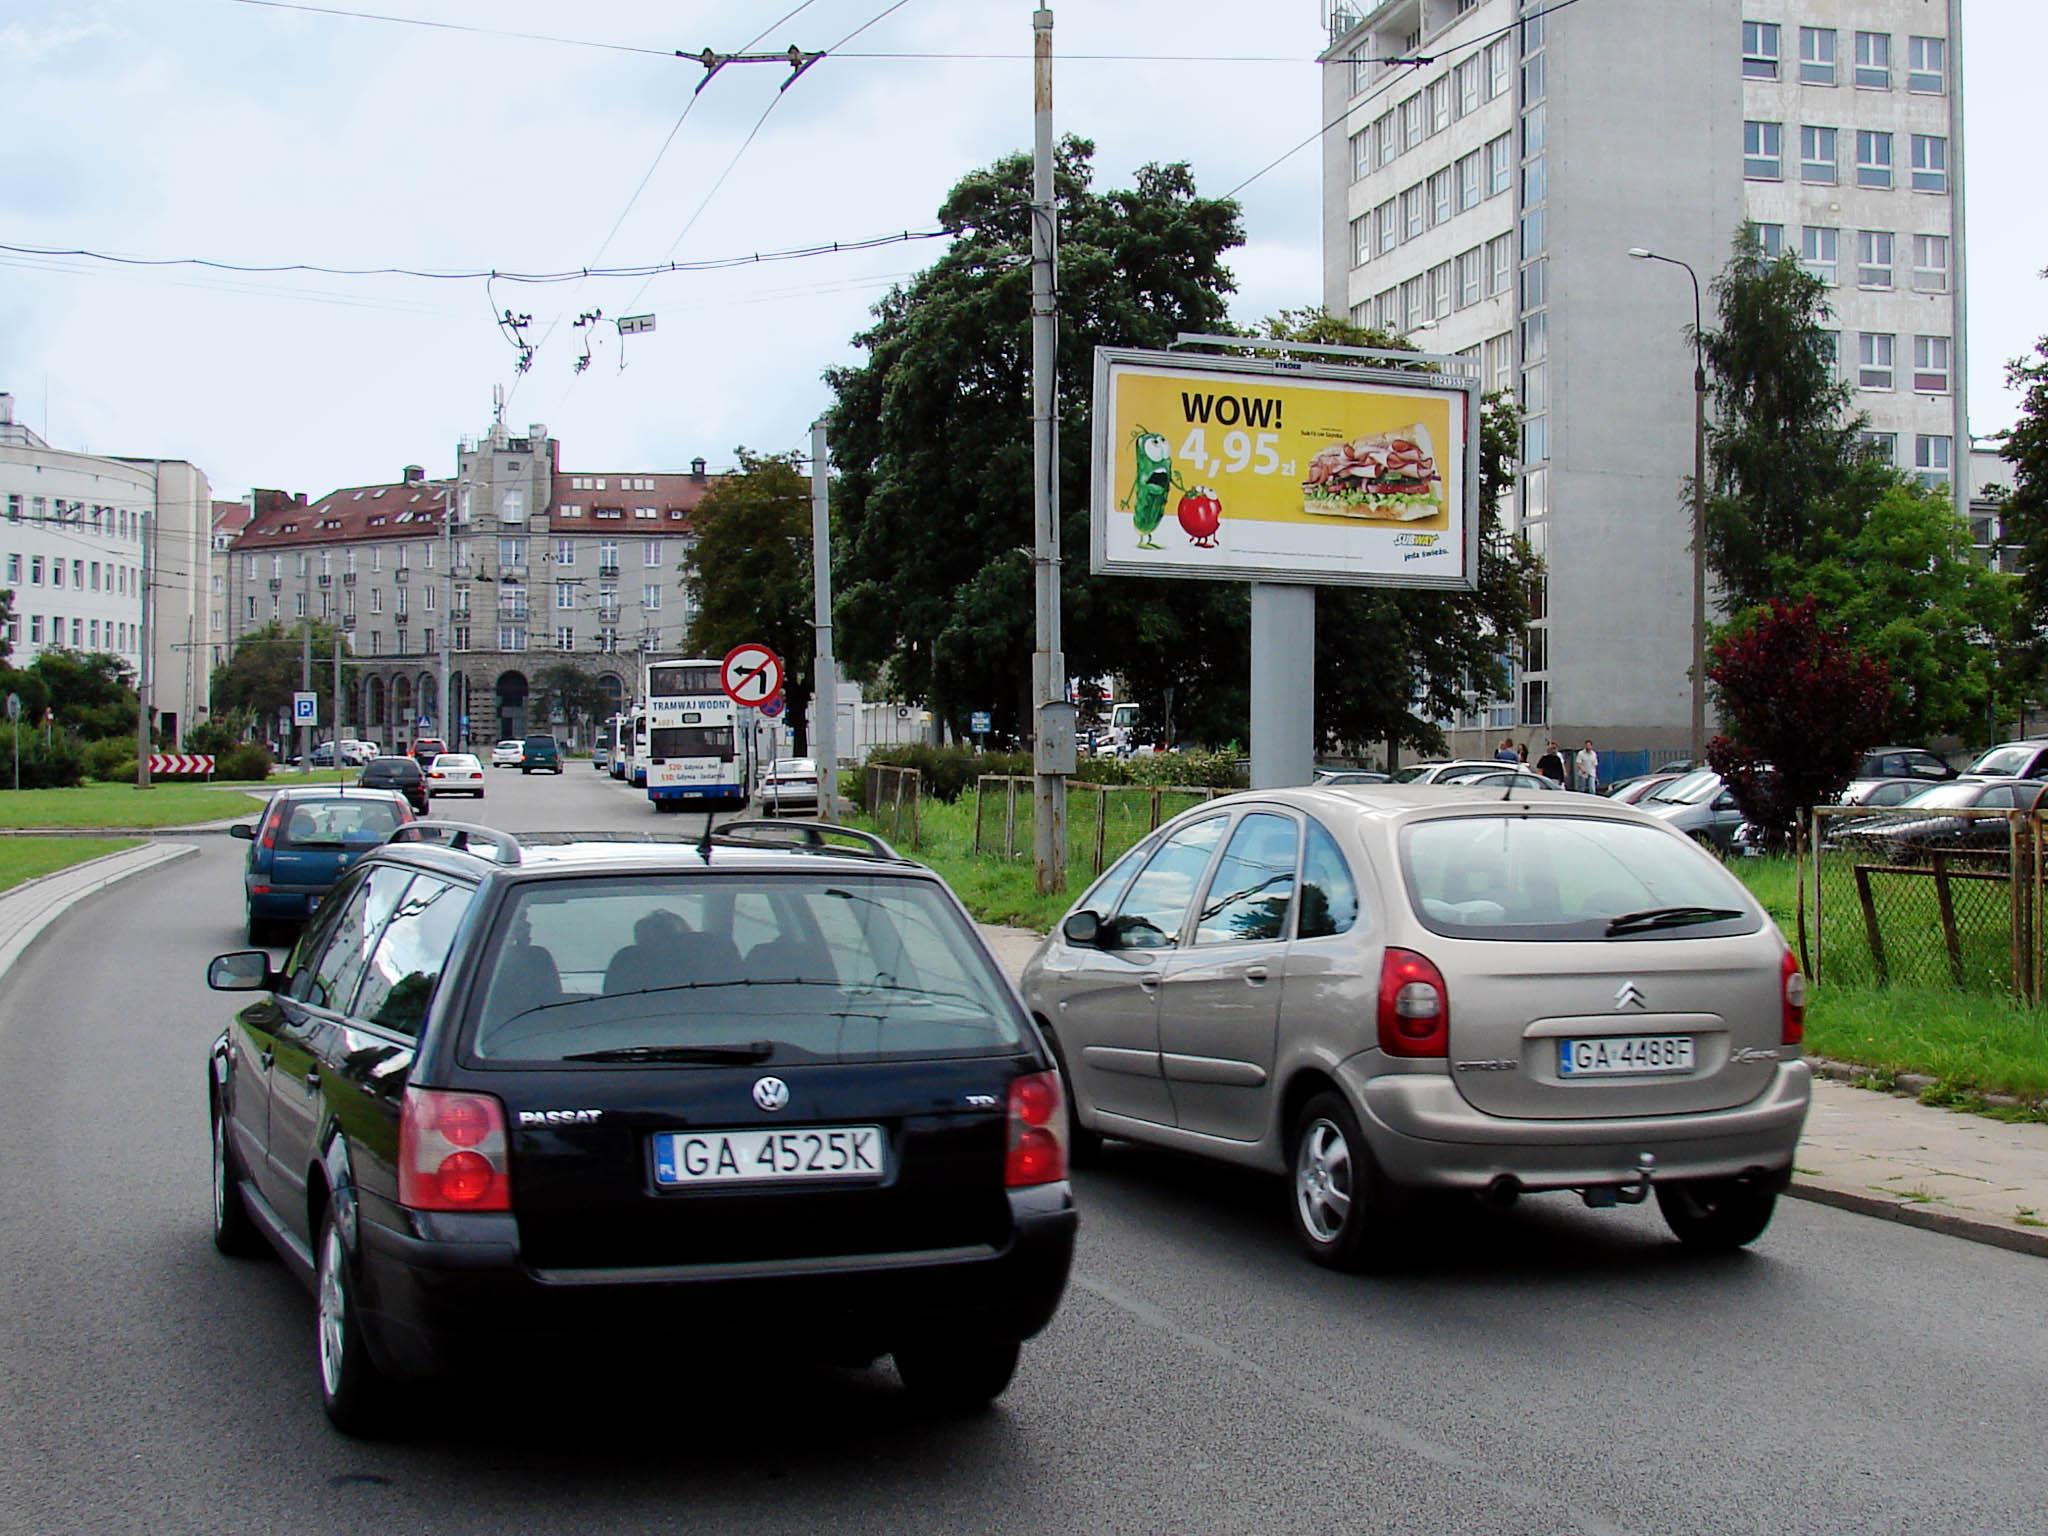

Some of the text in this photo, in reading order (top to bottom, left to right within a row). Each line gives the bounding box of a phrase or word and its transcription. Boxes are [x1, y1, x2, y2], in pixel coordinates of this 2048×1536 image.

[1181, 392, 1282, 429] WOW!
[1178, 428, 1280, 479] 4,95
[1393, 533, 1440, 546] SUBWAY
[300, 702, 311, 715] P
[653, 700, 731, 711] TRAMWAJ WODNY
[1576, 1039, 1690, 1068] GA 4488F
[519, 1109, 603, 1125] PASSAT
[684, 1132, 875, 1176] GA 4525K
